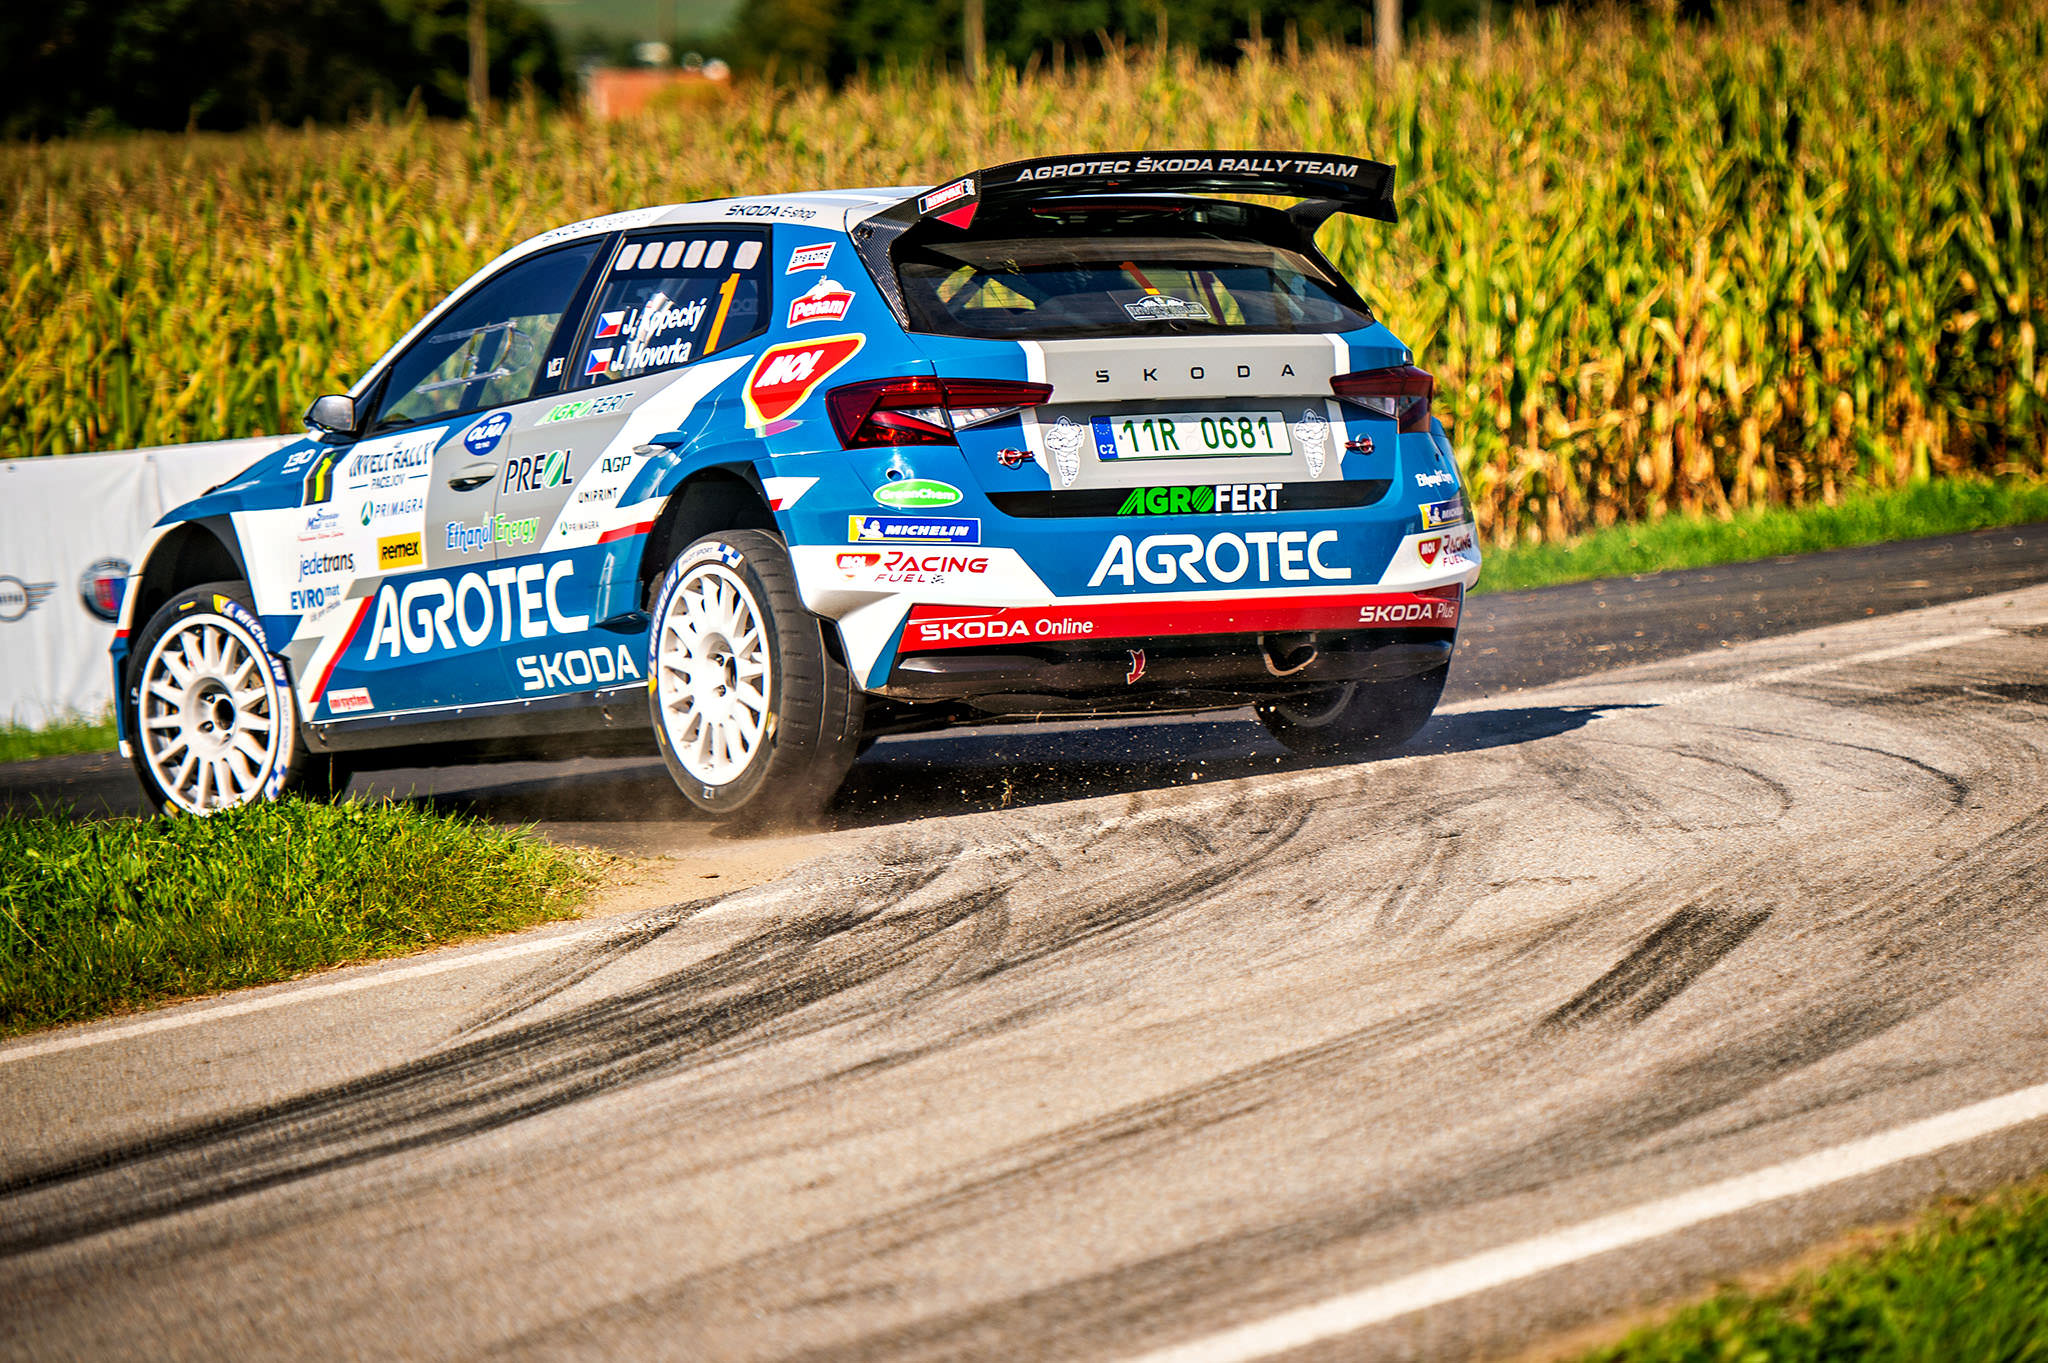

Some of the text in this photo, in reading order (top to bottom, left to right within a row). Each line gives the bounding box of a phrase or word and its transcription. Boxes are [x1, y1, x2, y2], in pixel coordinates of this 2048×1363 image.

[1016, 157, 1358, 182] AGROTEC ŠKODA RALLY TEAM
[640, 298, 707, 337] Kopecký
[703, 273, 740, 355] 1
[792, 301, 845, 321] Penam
[611, 337, 692, 371] J. Hovorka
[754, 350, 825, 388] MOL
[1123, 416, 1273, 452] 11R 0681
[393, 440, 435, 469] RALLY
[1100, 444, 1115, 454] CZ
[602, 456, 631, 473] AGP
[1117, 483, 1283, 515] AGROFERT
[885, 524, 970, 537] MICHELIN
[884, 551, 989, 573] RACING
[1087, 530, 1352, 588] AGROTEC
[874, 574, 926, 583] FUEL
[364, 559, 590, 661] AGROTEC
[1436, 603, 1455, 618] Plus
[1035, 618, 1094, 635] Online
